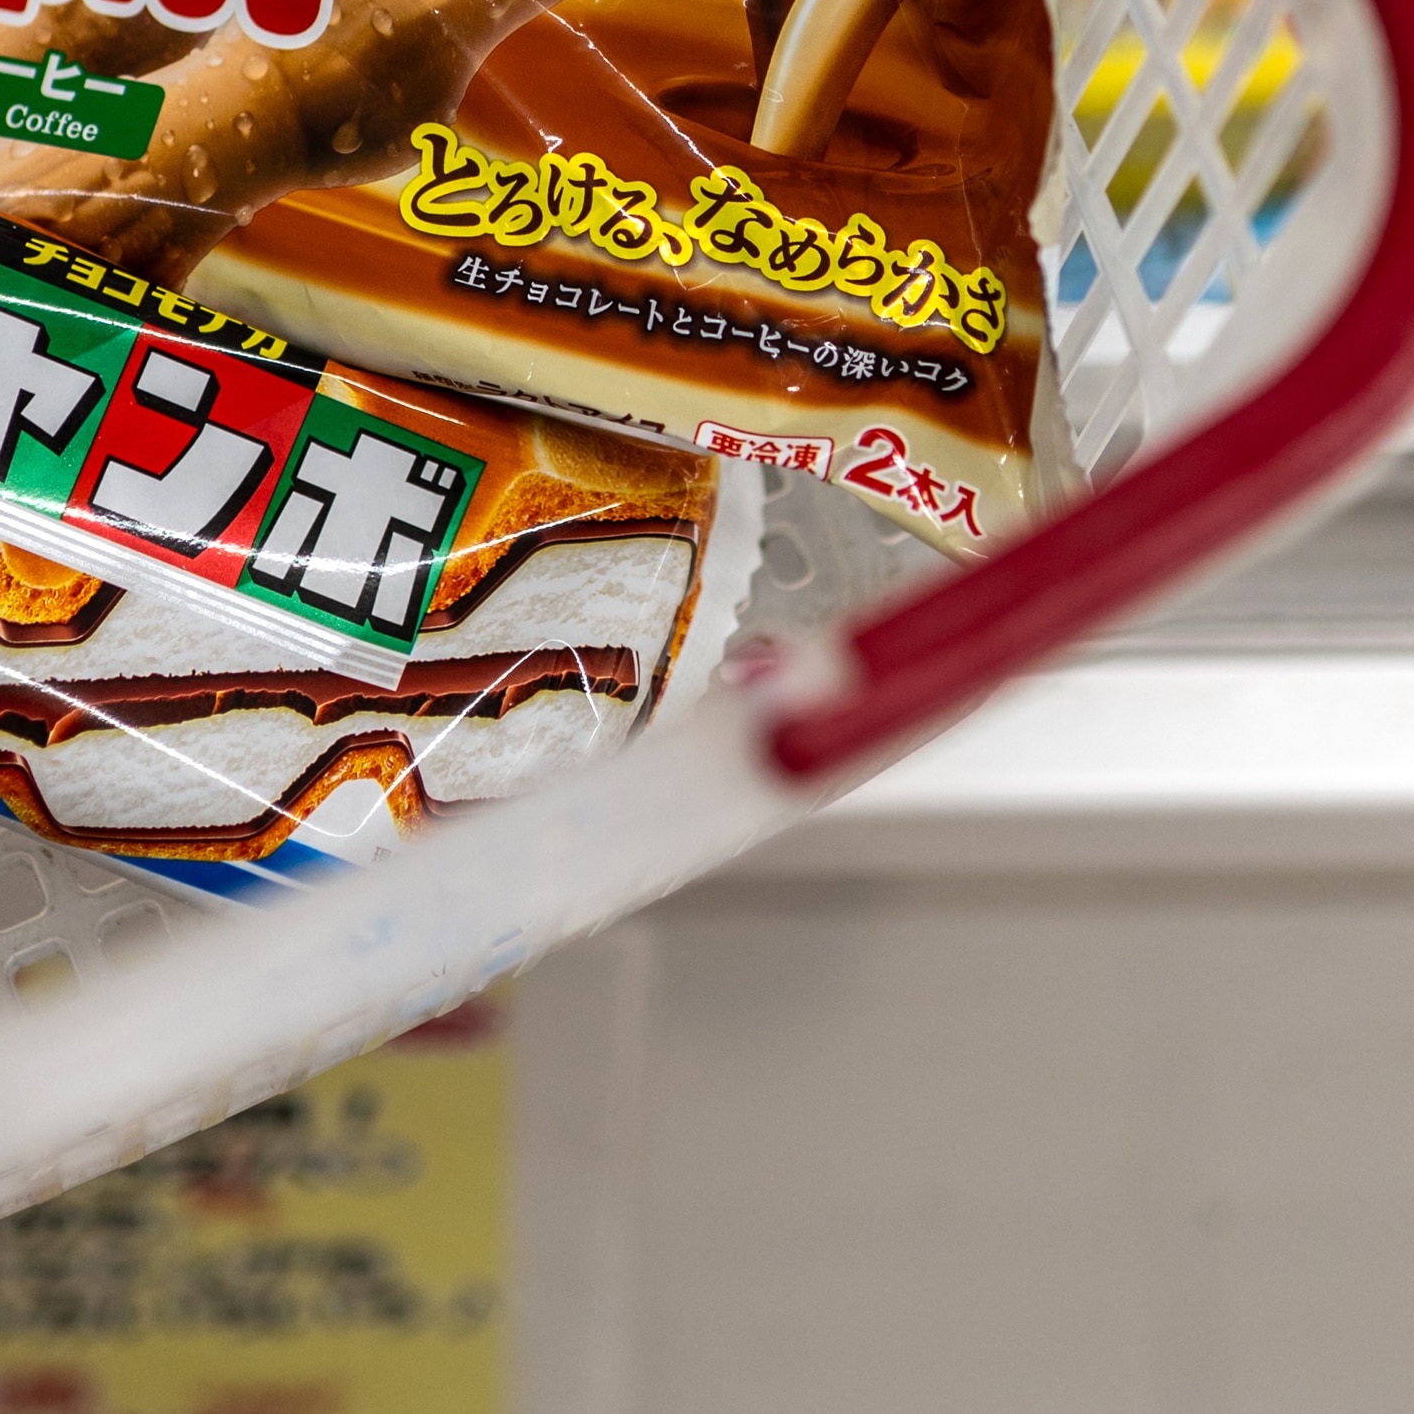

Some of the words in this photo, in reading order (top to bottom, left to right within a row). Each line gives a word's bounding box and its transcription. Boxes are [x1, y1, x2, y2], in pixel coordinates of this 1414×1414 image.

[6, 103, 99, 143] Coffee
[23, 238, 288, 360] チョコモナカ
[454, 256, 971, 392] 生チョコレートとコーヒーの深いコク
[843, 428, 984, 538] 2本入
